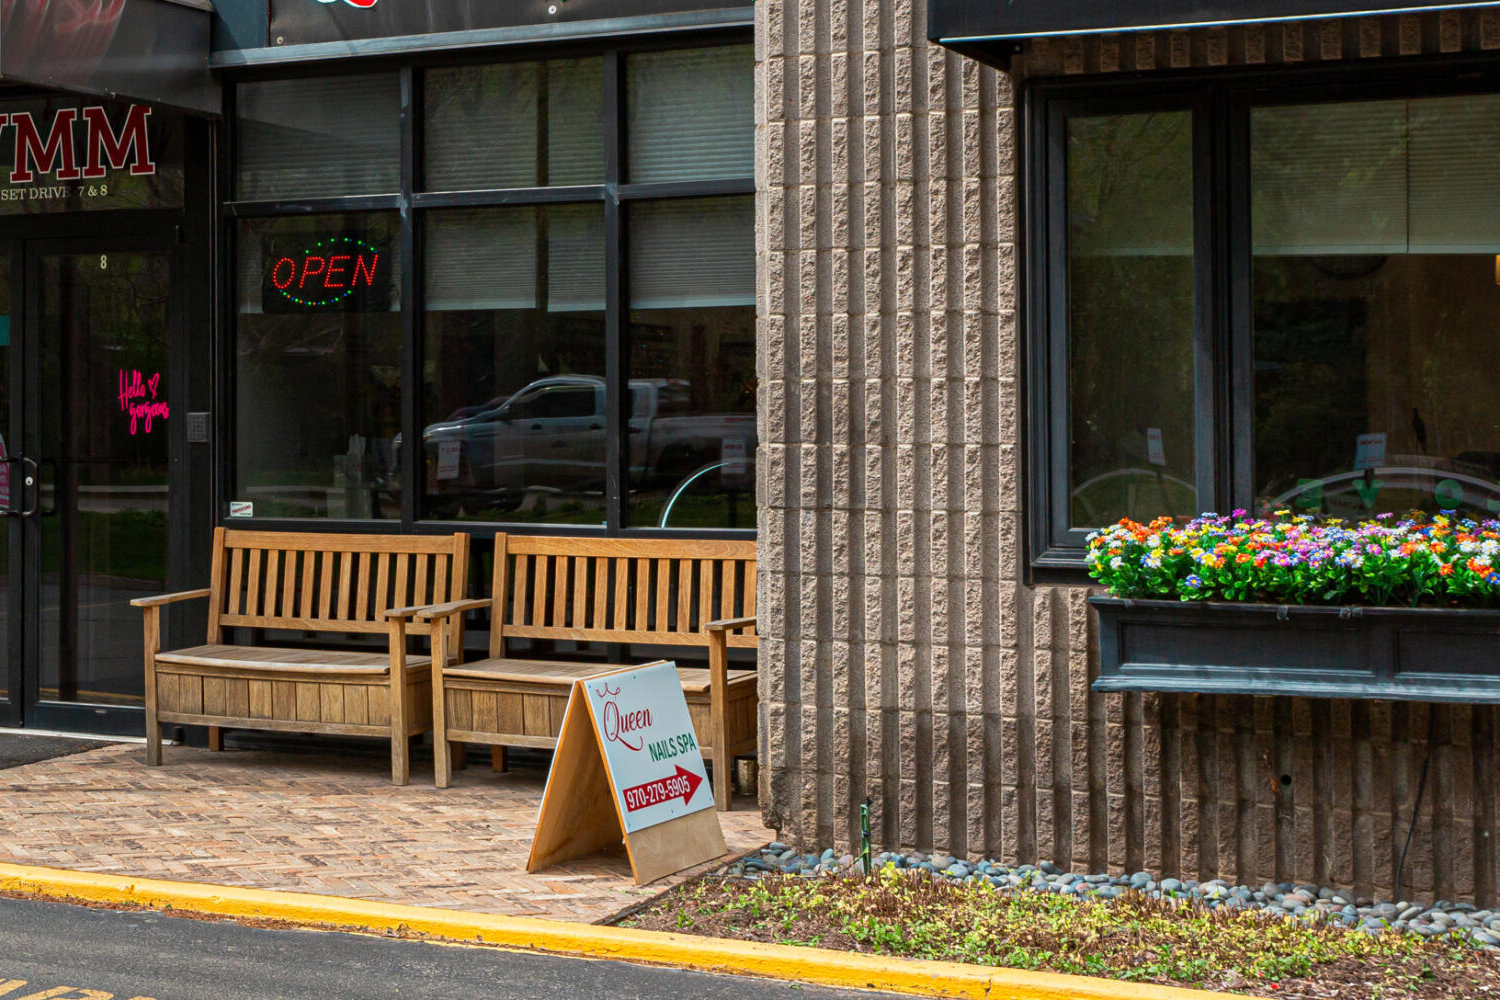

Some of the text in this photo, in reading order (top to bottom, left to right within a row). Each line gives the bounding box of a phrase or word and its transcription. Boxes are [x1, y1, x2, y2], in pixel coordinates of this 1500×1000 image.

[29, 185, 72, 199] DRIVE
[78, 185, 85, 198] 7
[100, 184, 108, 197] 8
[100, 254, 108, 270] 8
[271, 253, 379, 290] OPEN
[117, 367, 146, 411] Hello
[603, 701, 653, 751] Queen
[648, 732, 697, 762] NAILS SPA
[626, 775, 691, 810] 970-279-5905
